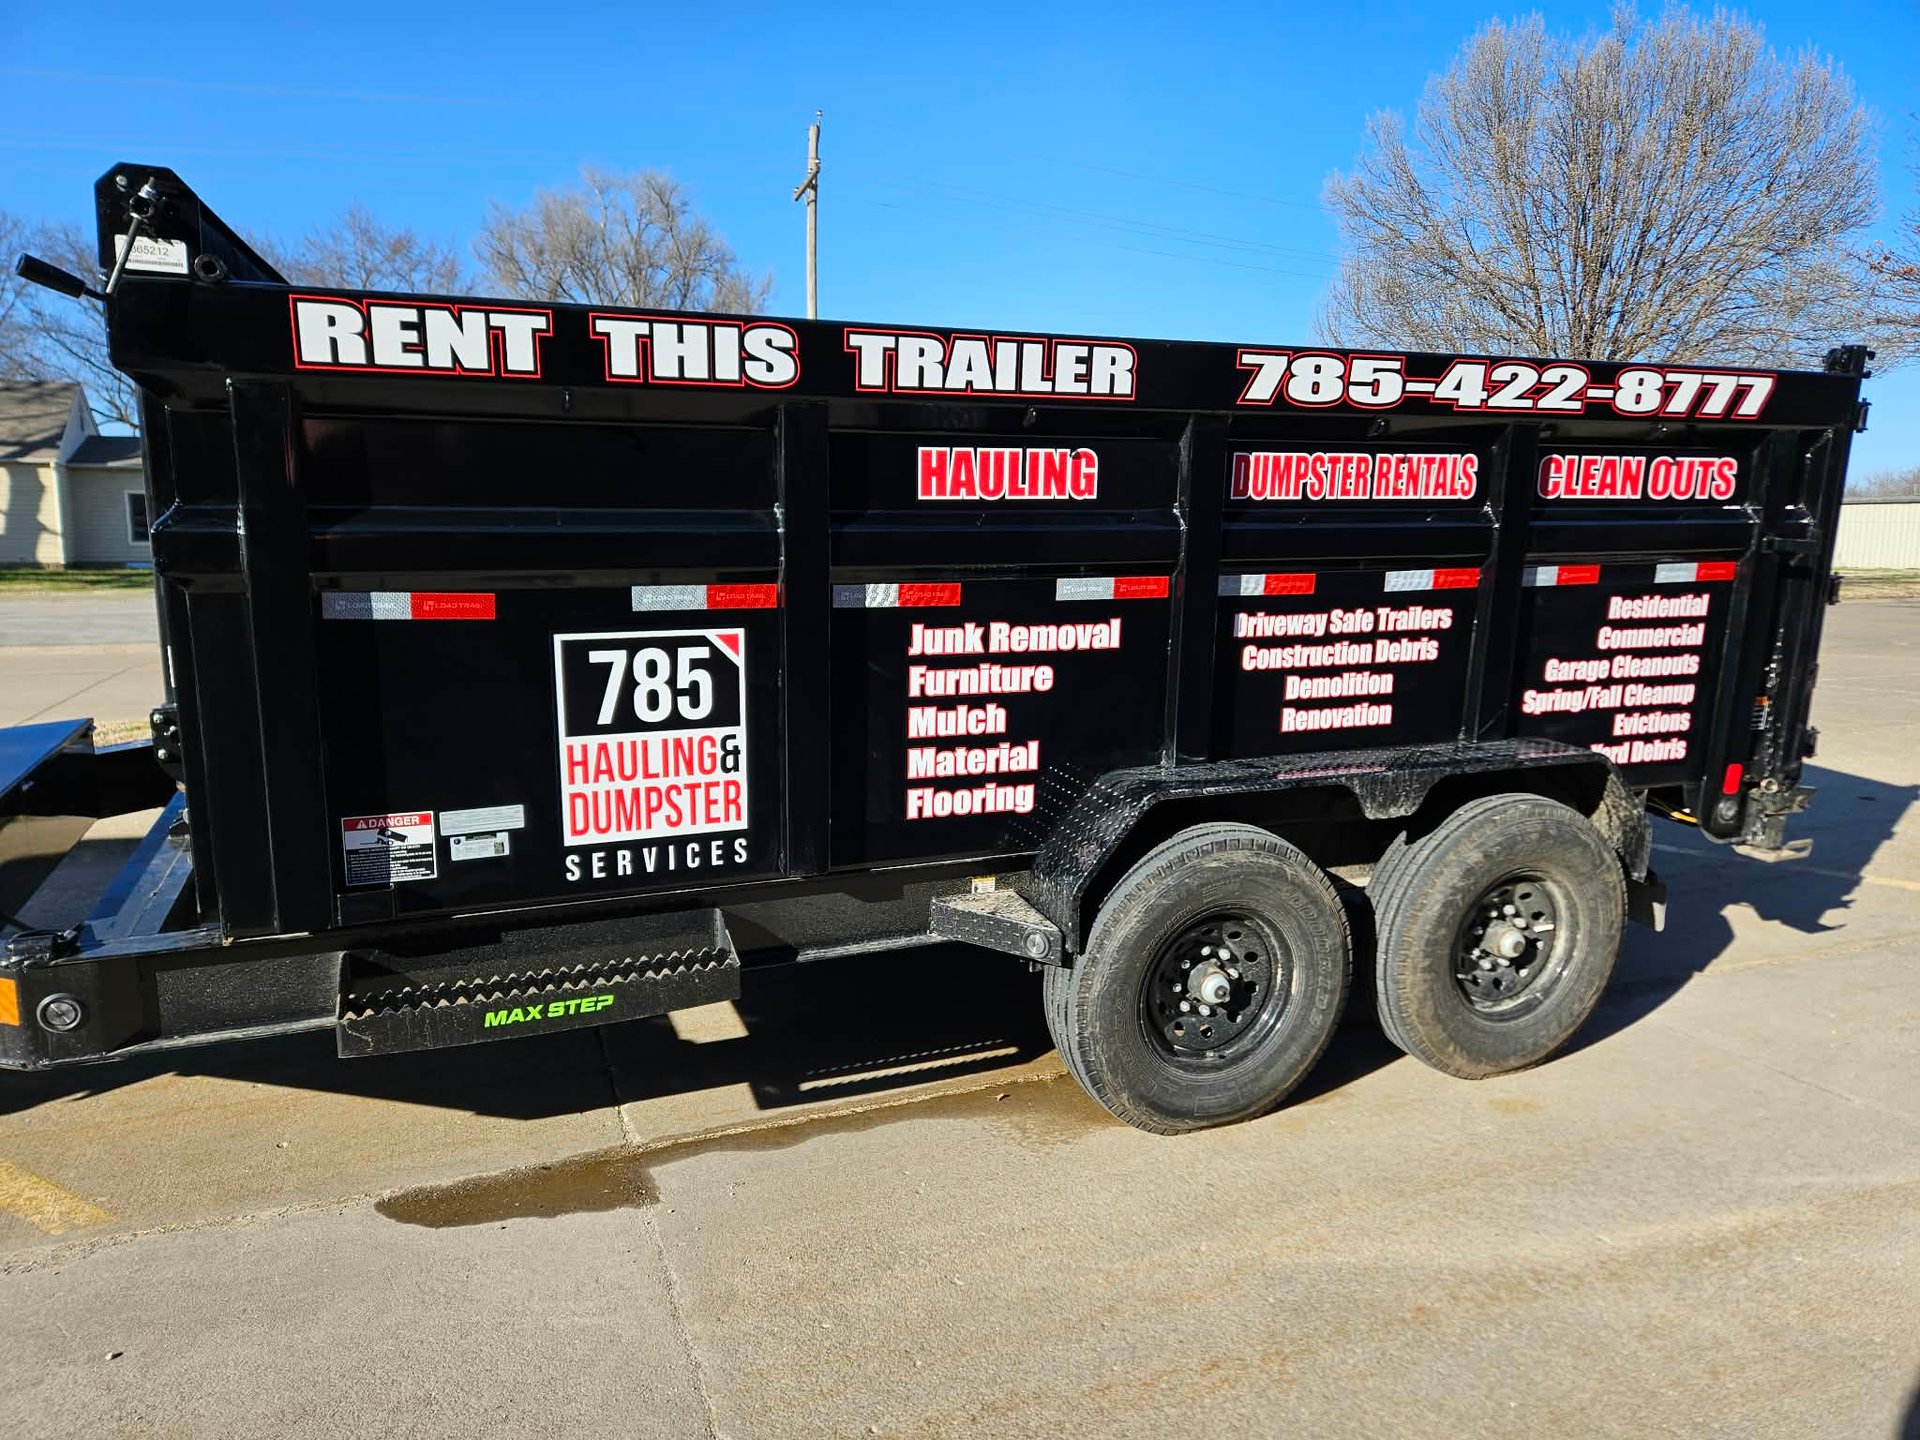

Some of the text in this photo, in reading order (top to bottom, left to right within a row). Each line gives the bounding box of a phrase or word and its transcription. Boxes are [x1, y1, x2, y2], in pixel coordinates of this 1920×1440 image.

[292, 297, 1136, 398] RENT THIS TRAILER
[1238, 350, 1774, 417] 785-422-8777
[918, 446, 1098, 500] HAULING
[1231, 452, 1478, 500] DUMPSTER RENTALS
[1538, 454, 1737, 500] CLEAN OUTS
[1234, 605, 1453, 638] Driveway Safe Trailers
[1607, 593, 1711, 620] Residential
[908, 617, 1122, 656] Junk Removal
[1241, 637, 1439, 671] Construction Debris
[1597, 622, 1706, 650] Commercial
[588, 646, 713, 725] 785
[908, 662, 1054, 698] Furniture
[1544, 653, 1700, 682] Garage Cleanouts
[1284, 671, 1394, 701] Demolition
[1522, 683, 1696, 715] Spring/Fall Cleanup
[907, 702, 1007, 739] Mulch
[1280, 703, 1393, 733] Renovation
[1612, 711, 1692, 737] Evictions
[907, 739, 1040, 780] Material
[1630, 737, 1688, 765] Debris
[569, 779, 742, 837] DUMPSTER
[906, 781, 1036, 820] Flooring
[368, 816, 420, 828] DANGER
[565, 837, 748, 882] SERVICES
[484, 994, 615, 1028] MAX STEP
